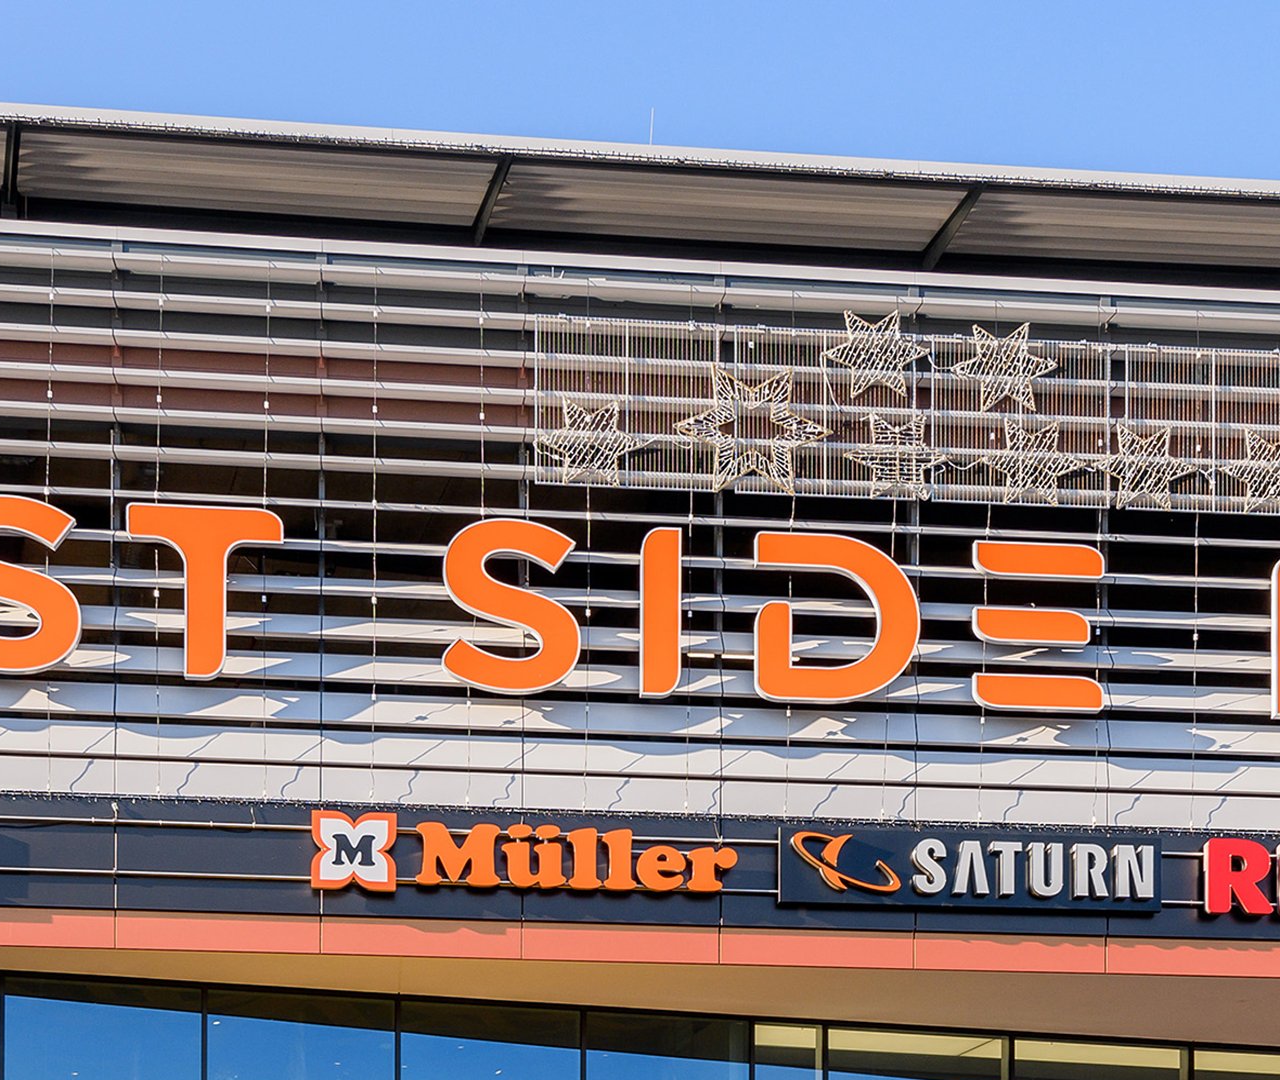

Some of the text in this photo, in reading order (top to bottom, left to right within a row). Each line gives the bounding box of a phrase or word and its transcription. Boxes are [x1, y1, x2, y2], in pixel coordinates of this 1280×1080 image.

[441, 517, 1106, 713] SIDE
[415, 821, 738, 893] Müller
[910, 837, 1155, 899] SATURN
